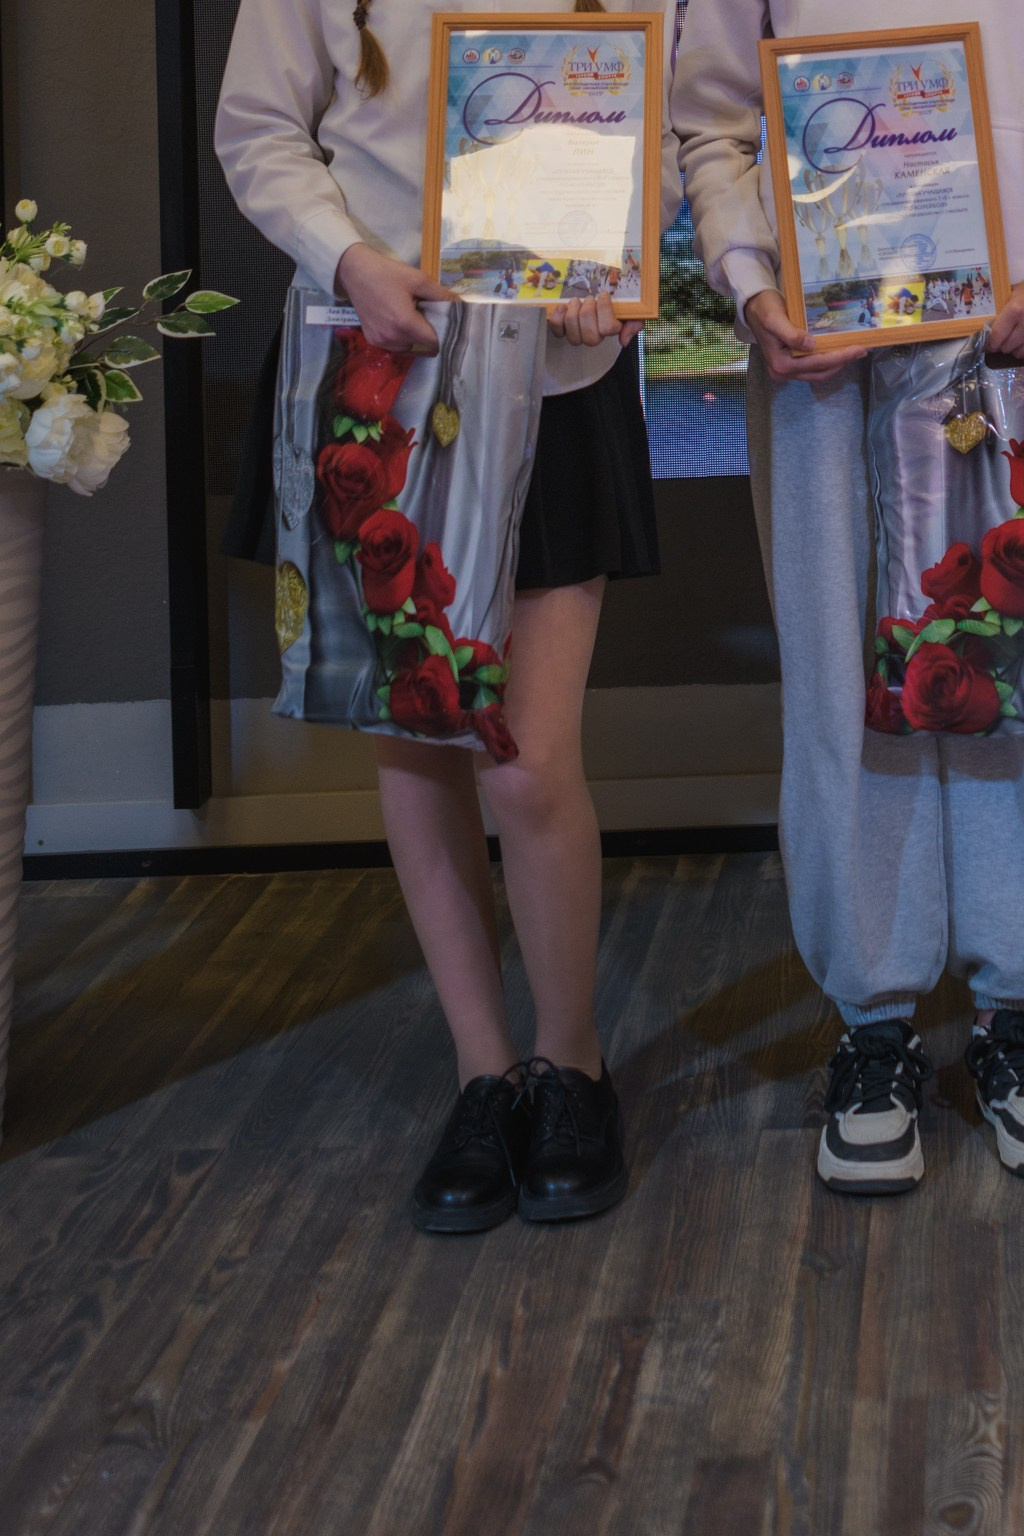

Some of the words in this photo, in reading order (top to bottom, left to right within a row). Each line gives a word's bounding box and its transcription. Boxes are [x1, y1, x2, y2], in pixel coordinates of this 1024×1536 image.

[464, 72, 626, 145] Диплом
[802, 98, 957, 174] Диплом
[894, 166, 950, 180] КАМЕНСКАЯ
[903, 160, 939, 168] Настасья
